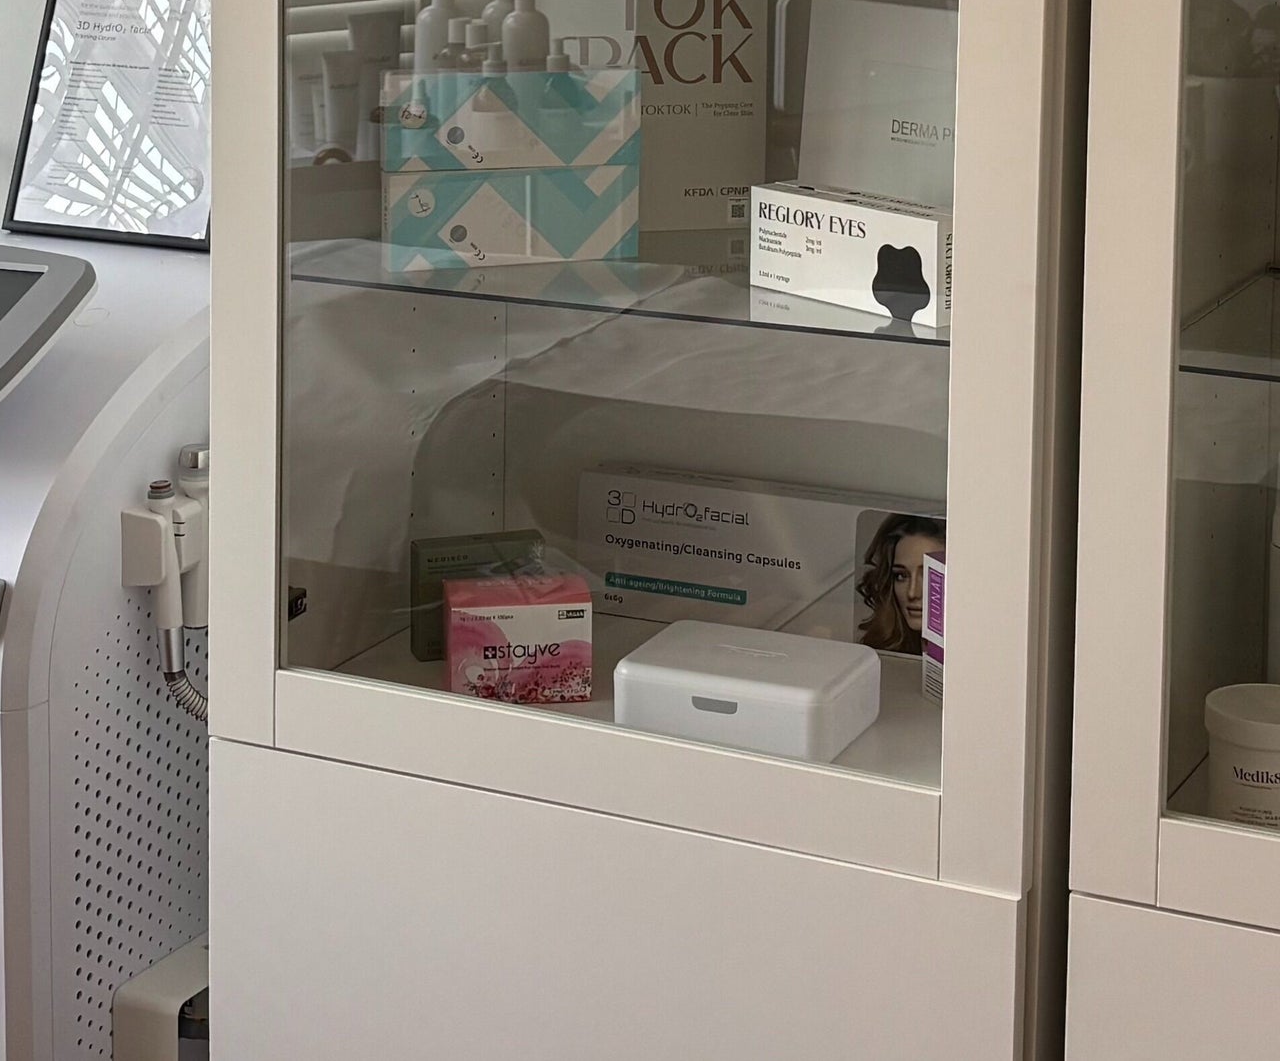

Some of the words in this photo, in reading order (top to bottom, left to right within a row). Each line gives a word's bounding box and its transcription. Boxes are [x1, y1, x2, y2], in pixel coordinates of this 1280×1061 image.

[76, 20, 91, 31] 3D
[891, 118, 939, 141] DERMA
[684, 187, 714, 197] KFDA
[720, 186, 749, 196] CPNP
[758, 201, 826, 230] REGLORY
[829, 215, 867, 239] EYES
[605, 533, 743, 564] Oxygenating/Cleansing
[745, 552, 801, 570] Capsules
[706, 588, 742, 602] Formula
[497, 641, 561, 664] stayve
